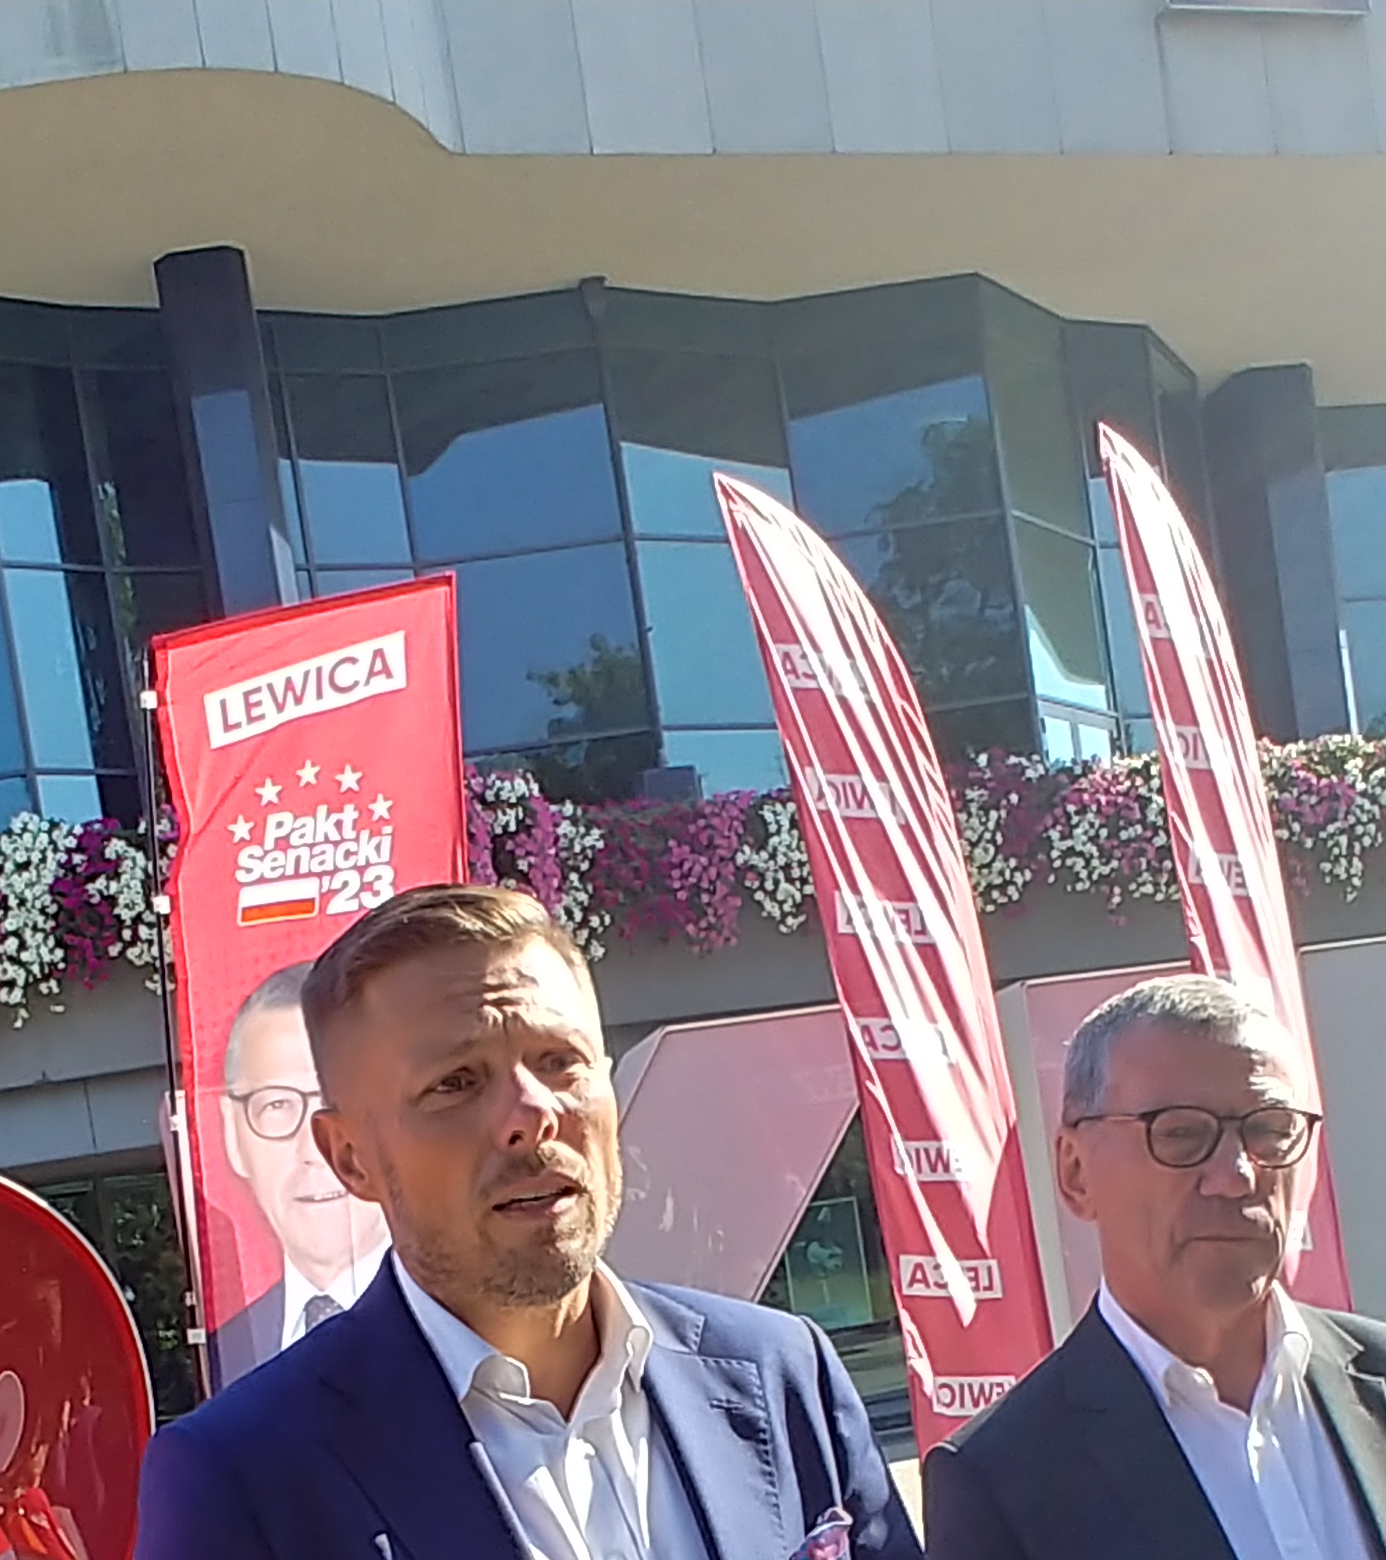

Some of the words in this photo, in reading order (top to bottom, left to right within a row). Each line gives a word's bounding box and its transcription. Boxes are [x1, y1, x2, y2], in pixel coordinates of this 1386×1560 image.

[219, 647, 394, 733] LEWICA
[235, 827, 394, 883] Senacki
[263, 804, 359, 850] Pakt
